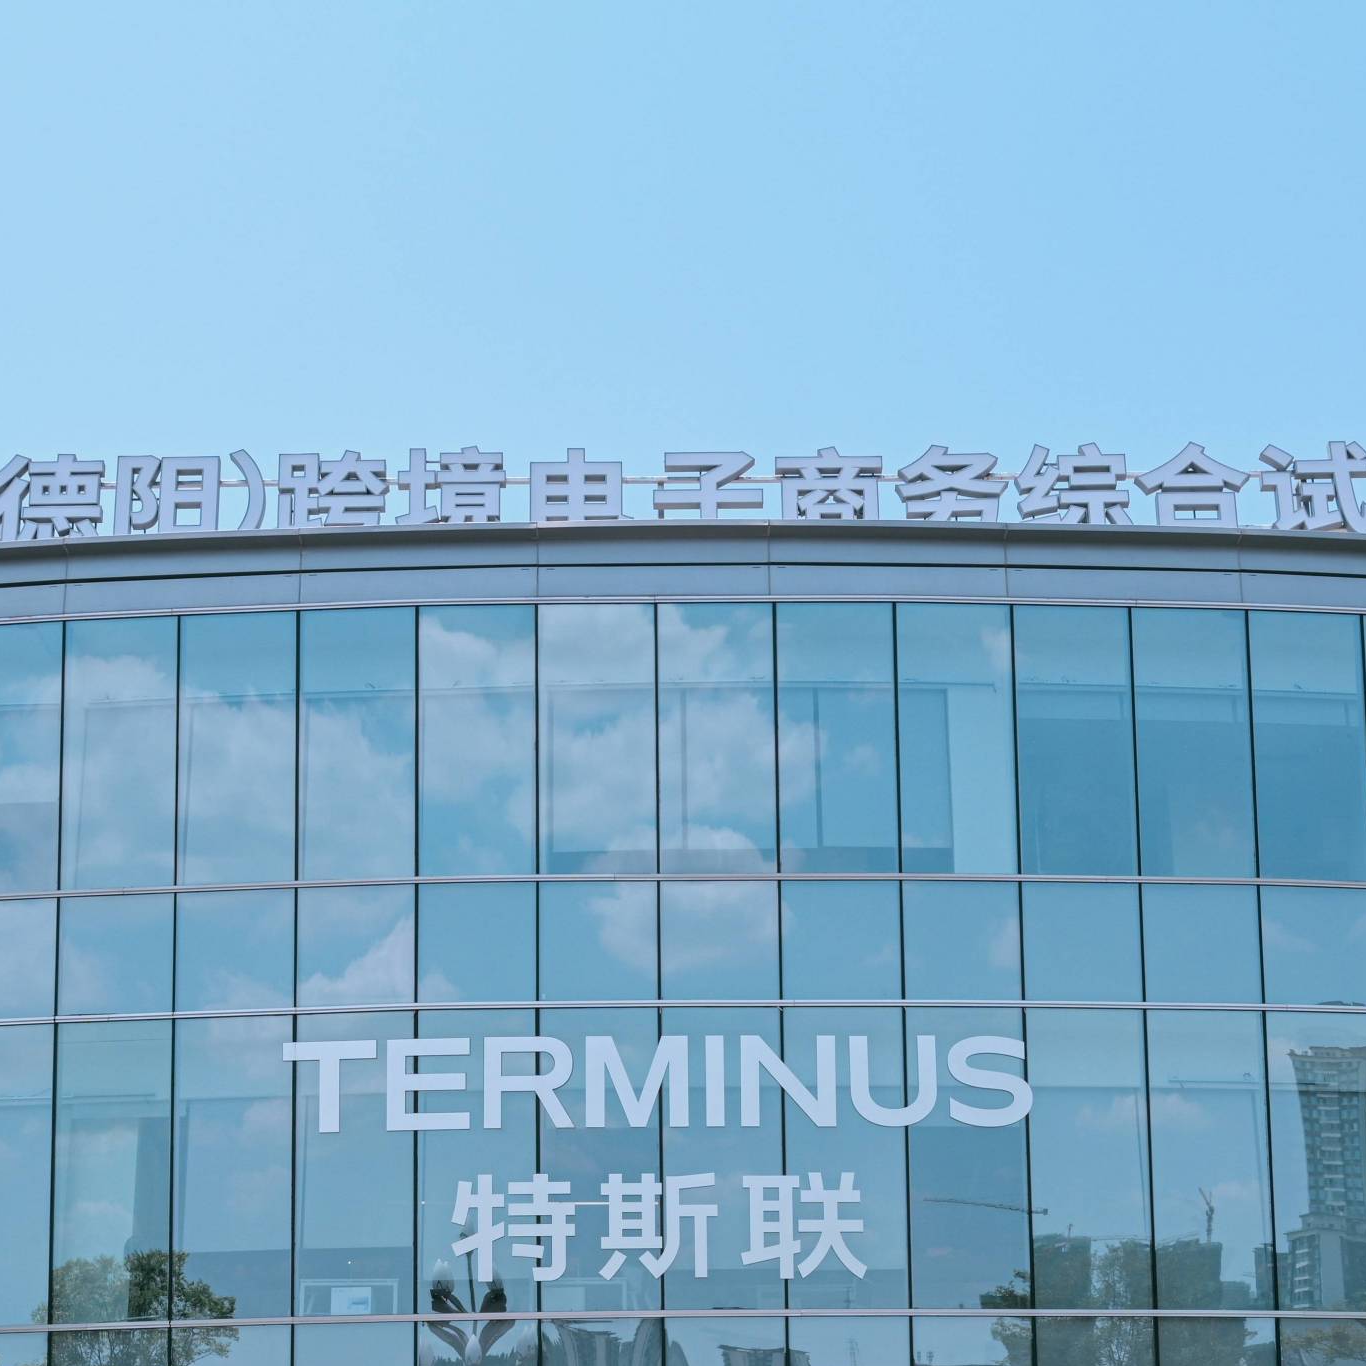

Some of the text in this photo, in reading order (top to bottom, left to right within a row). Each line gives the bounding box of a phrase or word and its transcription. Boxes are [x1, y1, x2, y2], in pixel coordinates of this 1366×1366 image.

[283, 1035, 1033, 1133] TERMINUS
[451, 1172, 867, 1283] 特斯联
